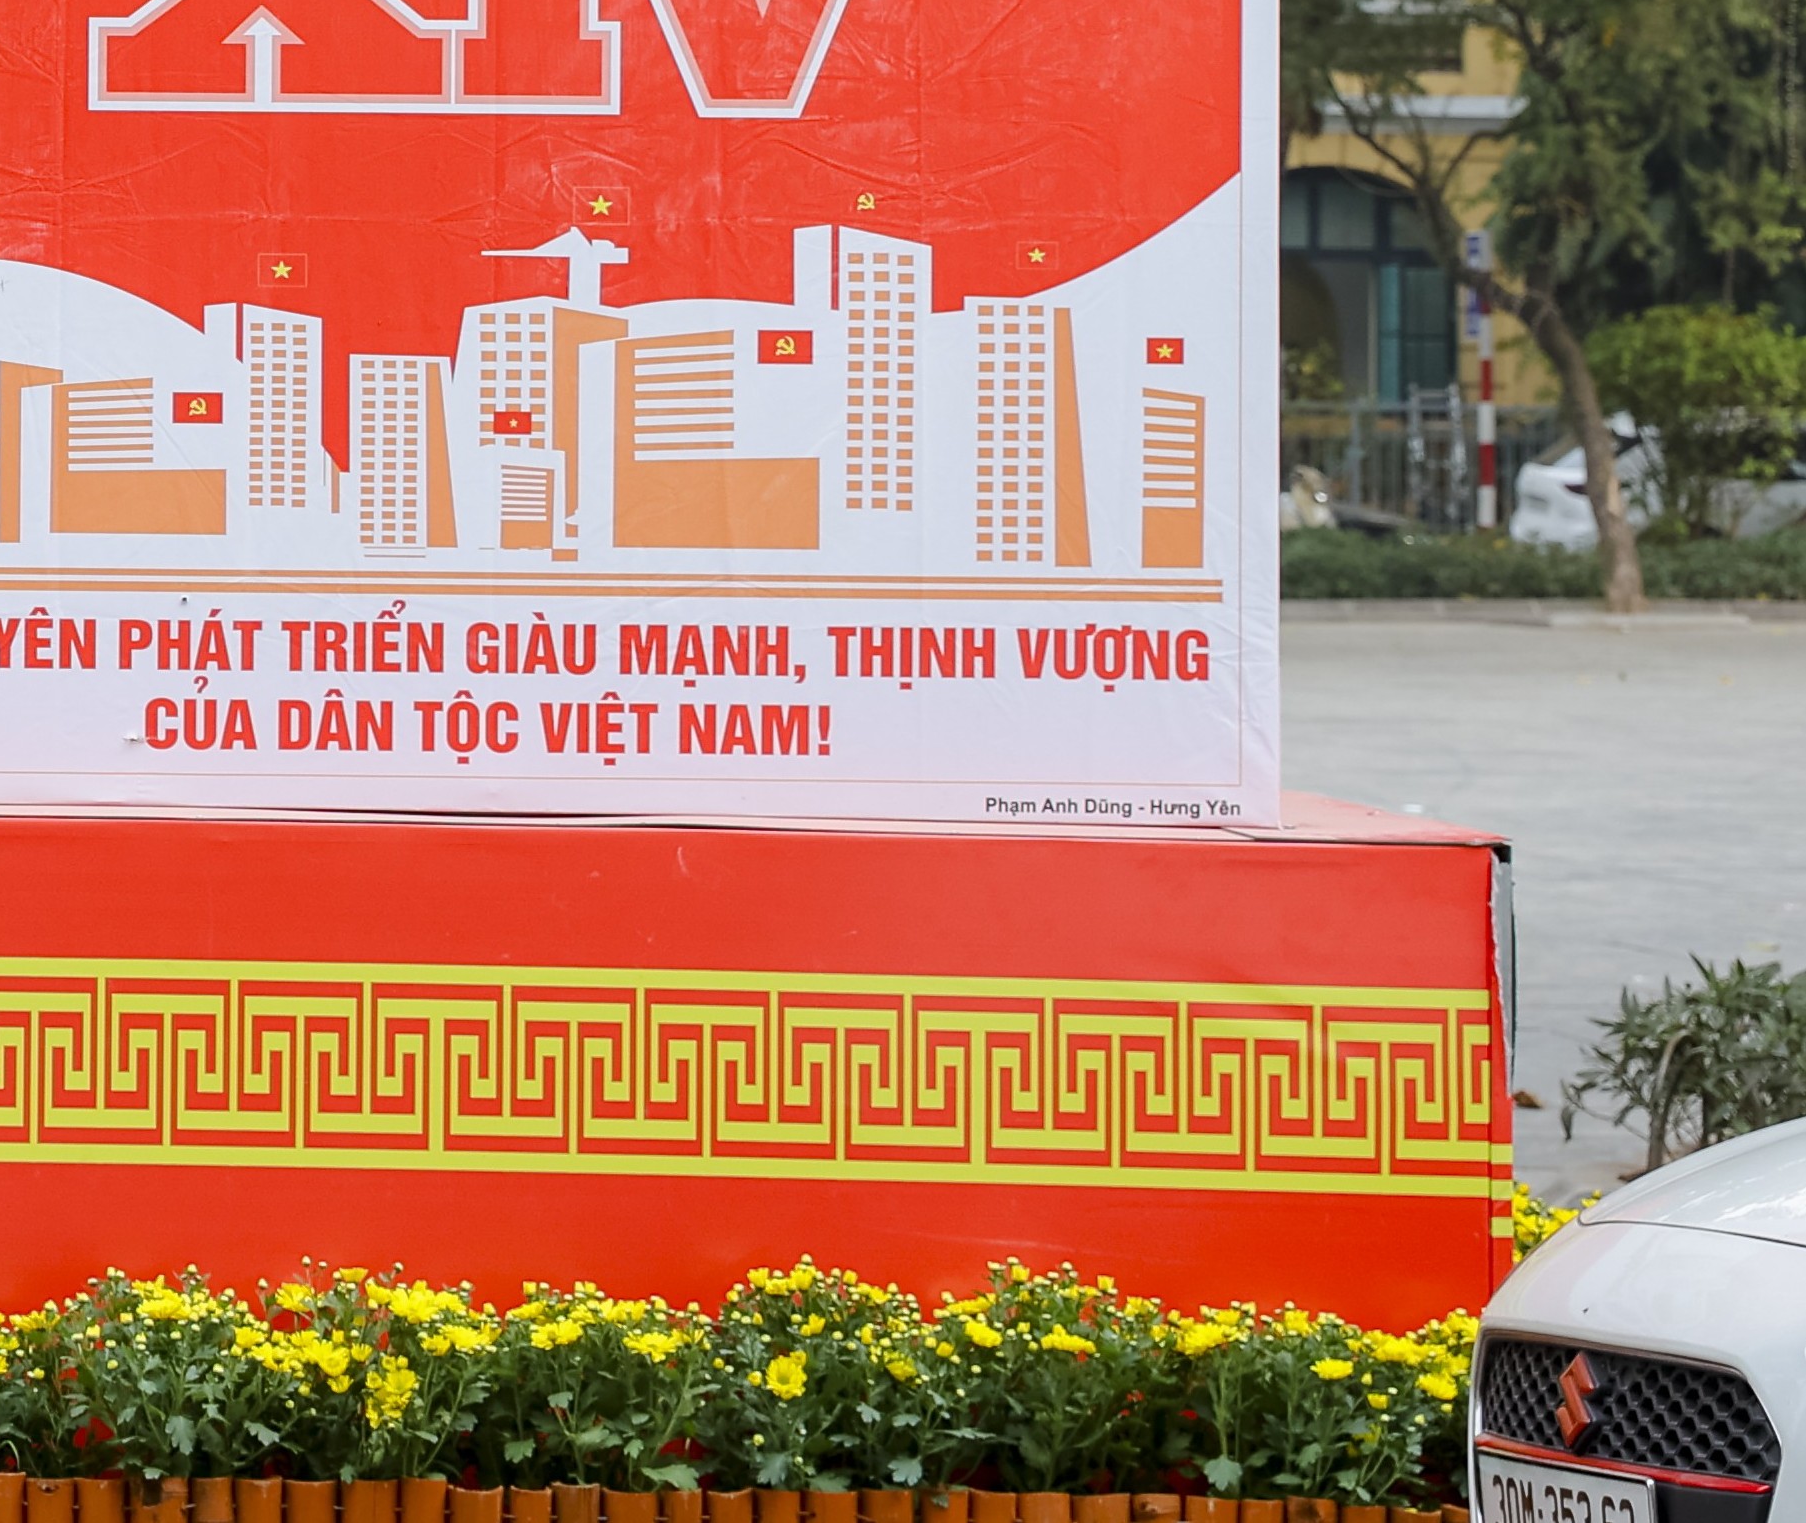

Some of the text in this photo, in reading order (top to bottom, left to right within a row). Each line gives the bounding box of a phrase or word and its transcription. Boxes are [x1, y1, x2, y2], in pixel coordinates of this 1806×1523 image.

[119, 610, 261, 670] PHÁT
[282, 601, 443, 672] TRIỂN
[467, 613, 596, 674] GIÀU
[620, 625, 805, 687] MẠNH,
[829, 627, 995, 689] THỊNH
[1018, 624, 1208, 691] VƯỢNG
[146, 677, 829, 765] CỦA DÂN TỘC VIỆT NAM!
[986, 797, 1036, 816] Phạm
[1041, 798, 1078, 813] Anh
[1084, 798, 1132, 818] Dũng
[1150, 799, 1200, 819] Hưng
[1206, 800, 1241, 816] Yên
